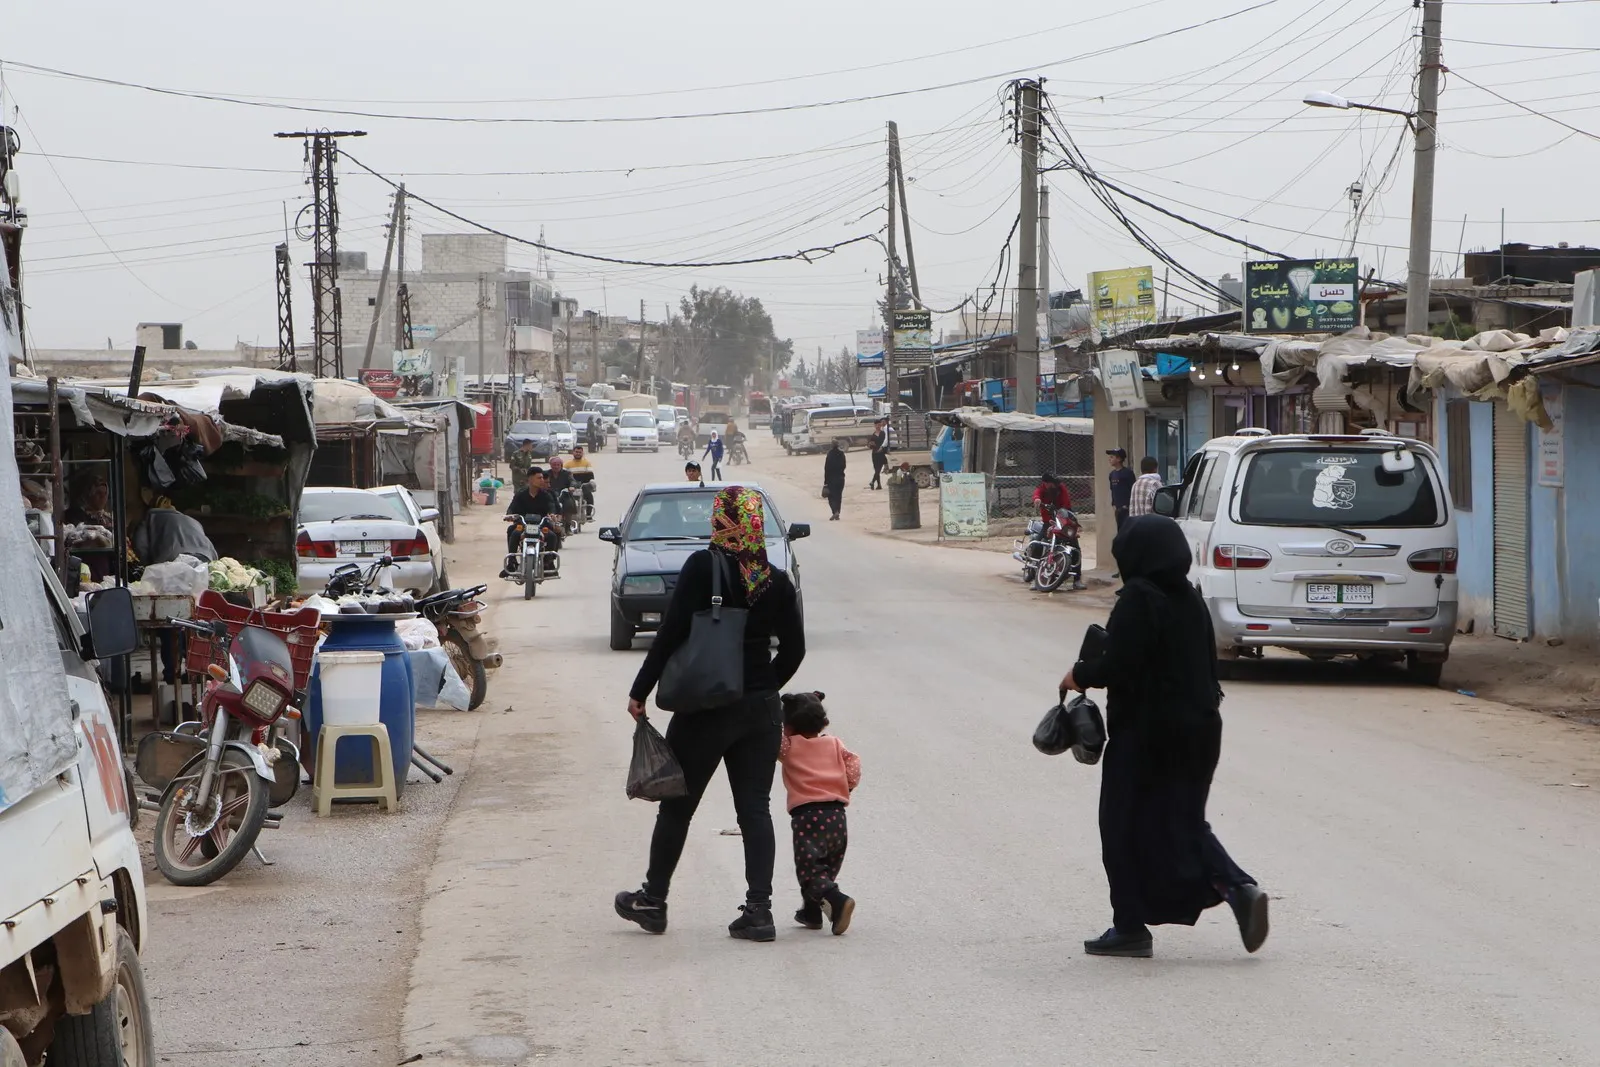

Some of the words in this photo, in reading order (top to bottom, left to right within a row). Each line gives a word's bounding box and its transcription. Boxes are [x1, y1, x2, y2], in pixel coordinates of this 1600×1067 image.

[1251, 262, 1279, 271] محمد
[1314, 261, 1355, 272] مجوهرات
[1320, 286, 1345, 297] حسن
